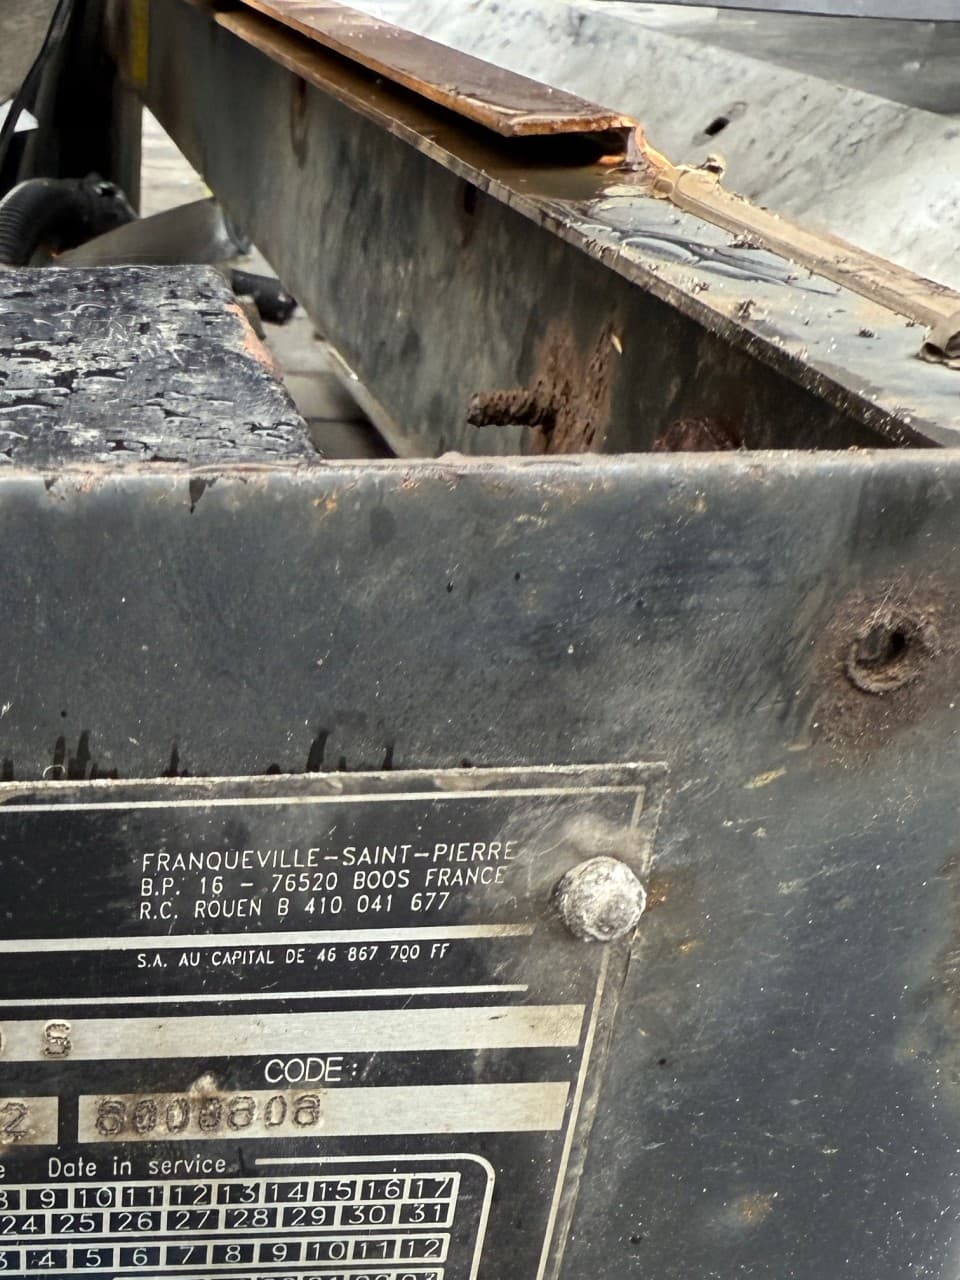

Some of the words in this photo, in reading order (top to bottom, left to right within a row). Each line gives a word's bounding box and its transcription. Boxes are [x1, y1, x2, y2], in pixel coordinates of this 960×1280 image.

[141, 877, 180, 897] B.P.
[200, 876, 224, 895] 16
[272, 873, 338, 893] 76520
[353, 870, 410, 890] BOOS
[425, 866, 506, 887] FRANCE
[140, 901, 178, 920] R.C.
[194, 898, 262, 918] ROUEN
[277, 896, 290, 916] B
[304, 895, 343, 915] 410
[357, 894, 393, 913] 041
[410, 892, 450, 912] 677
[137, 953, 168, 968] S.A.
[178, 952, 201, 967] AU
[211, 949, 275, 966] CAPITAL
[285, 948, 306, 964] DE
[316, 947, 336, 962] 46
[390, 945, 421, 962] 700
[430, 943, 450, 959] FF
[42, 1020, 72, 1060] S
[48, 1157, 97, 1177] Date
[112, 1157, 132, 1176] in
[148, 1154, 227, 1175] service
[79, 1186, 113, 1208] 10
[126, 1186, 155, 1207] 11
[174, 1184, 209, 1206] 12
[222, 1183, 257, 1204] 13
[270, 1181, 304, 1202] 14
[319, 1179, 353, 1200] 15
[368, 1178, 400, 1199] 16
[416, 1177, 452, 1199] 17
[0, 1215, 38, 1236] 24
[59, 1213, 96, 1233] 25
[117, 1211, 154, 1232] 26
[174, 1209, 211, 1230] 27
[232, 1208, 270, 1228] 28
[290, 1206, 327, 1227] 29
[348, 1204, 387, 1225] 30
[408, 1202, 442, 1223] 31
